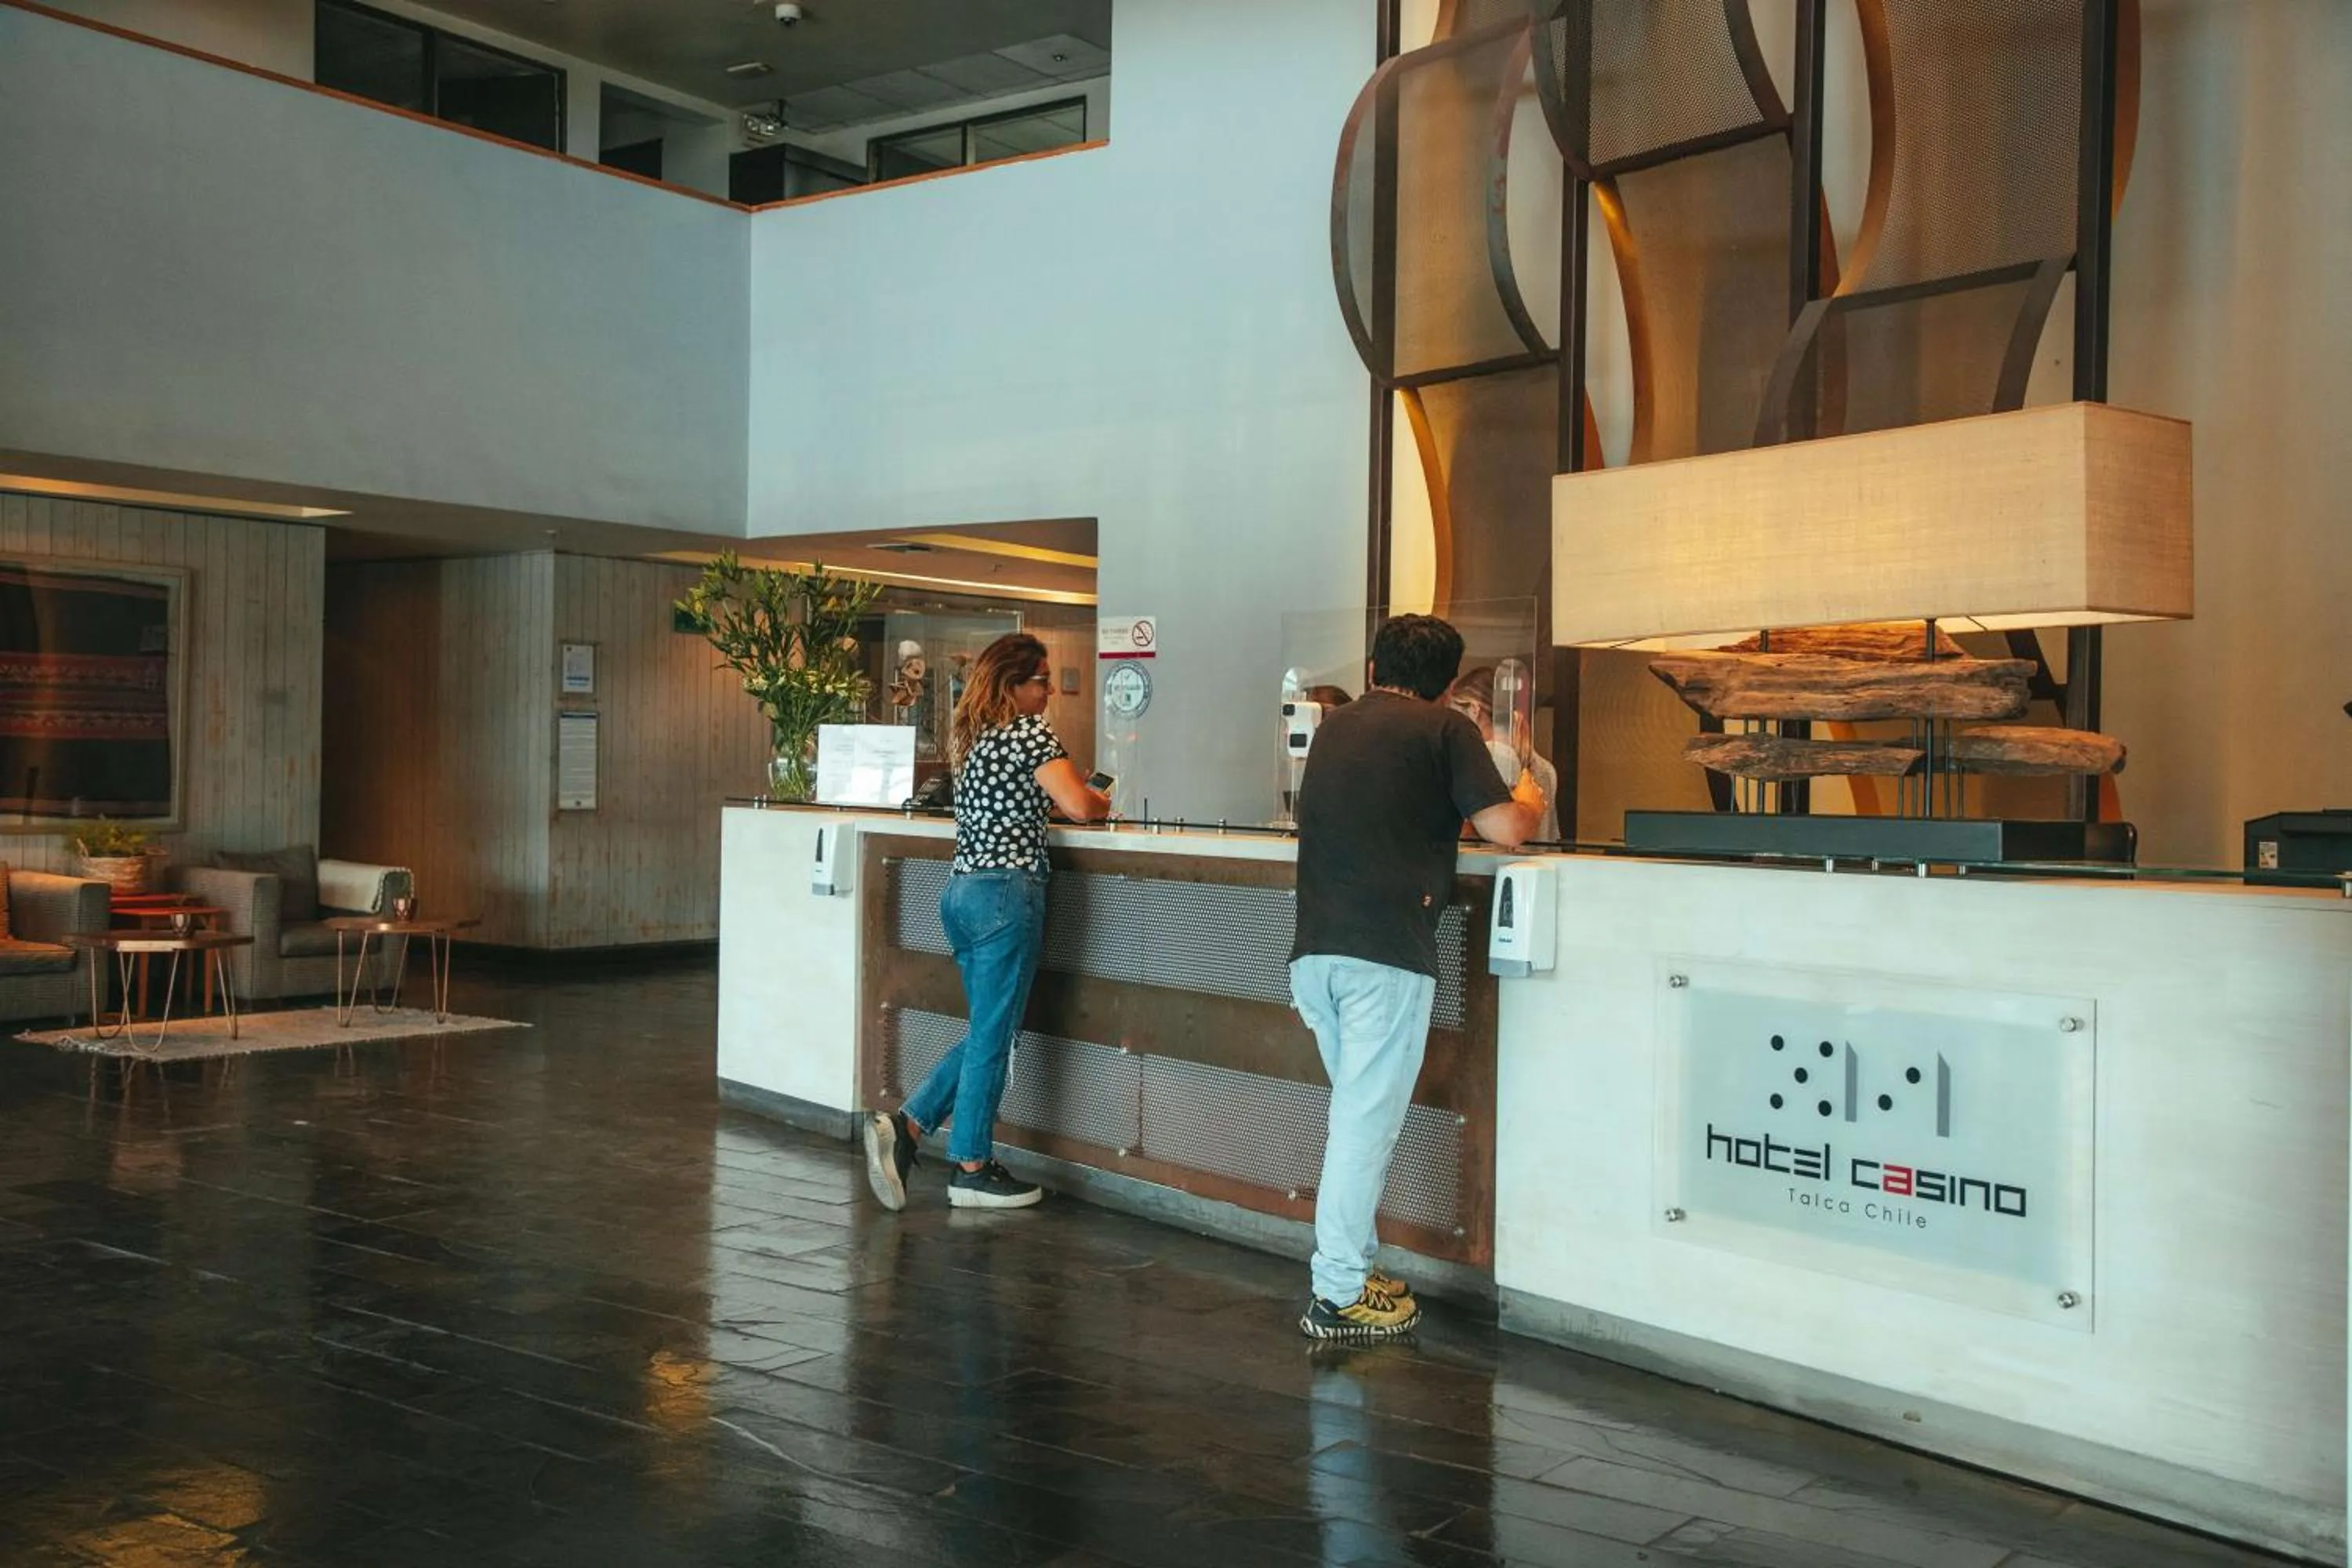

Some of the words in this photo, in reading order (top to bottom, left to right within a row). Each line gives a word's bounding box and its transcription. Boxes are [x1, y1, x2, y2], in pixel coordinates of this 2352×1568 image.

[1706, 1123, 1831, 1181] hotel
[1851, 1158, 2027, 1218] casino
[1788, 1188, 1850, 1214] Talca
[1865, 1203, 1928, 1229] Chile
